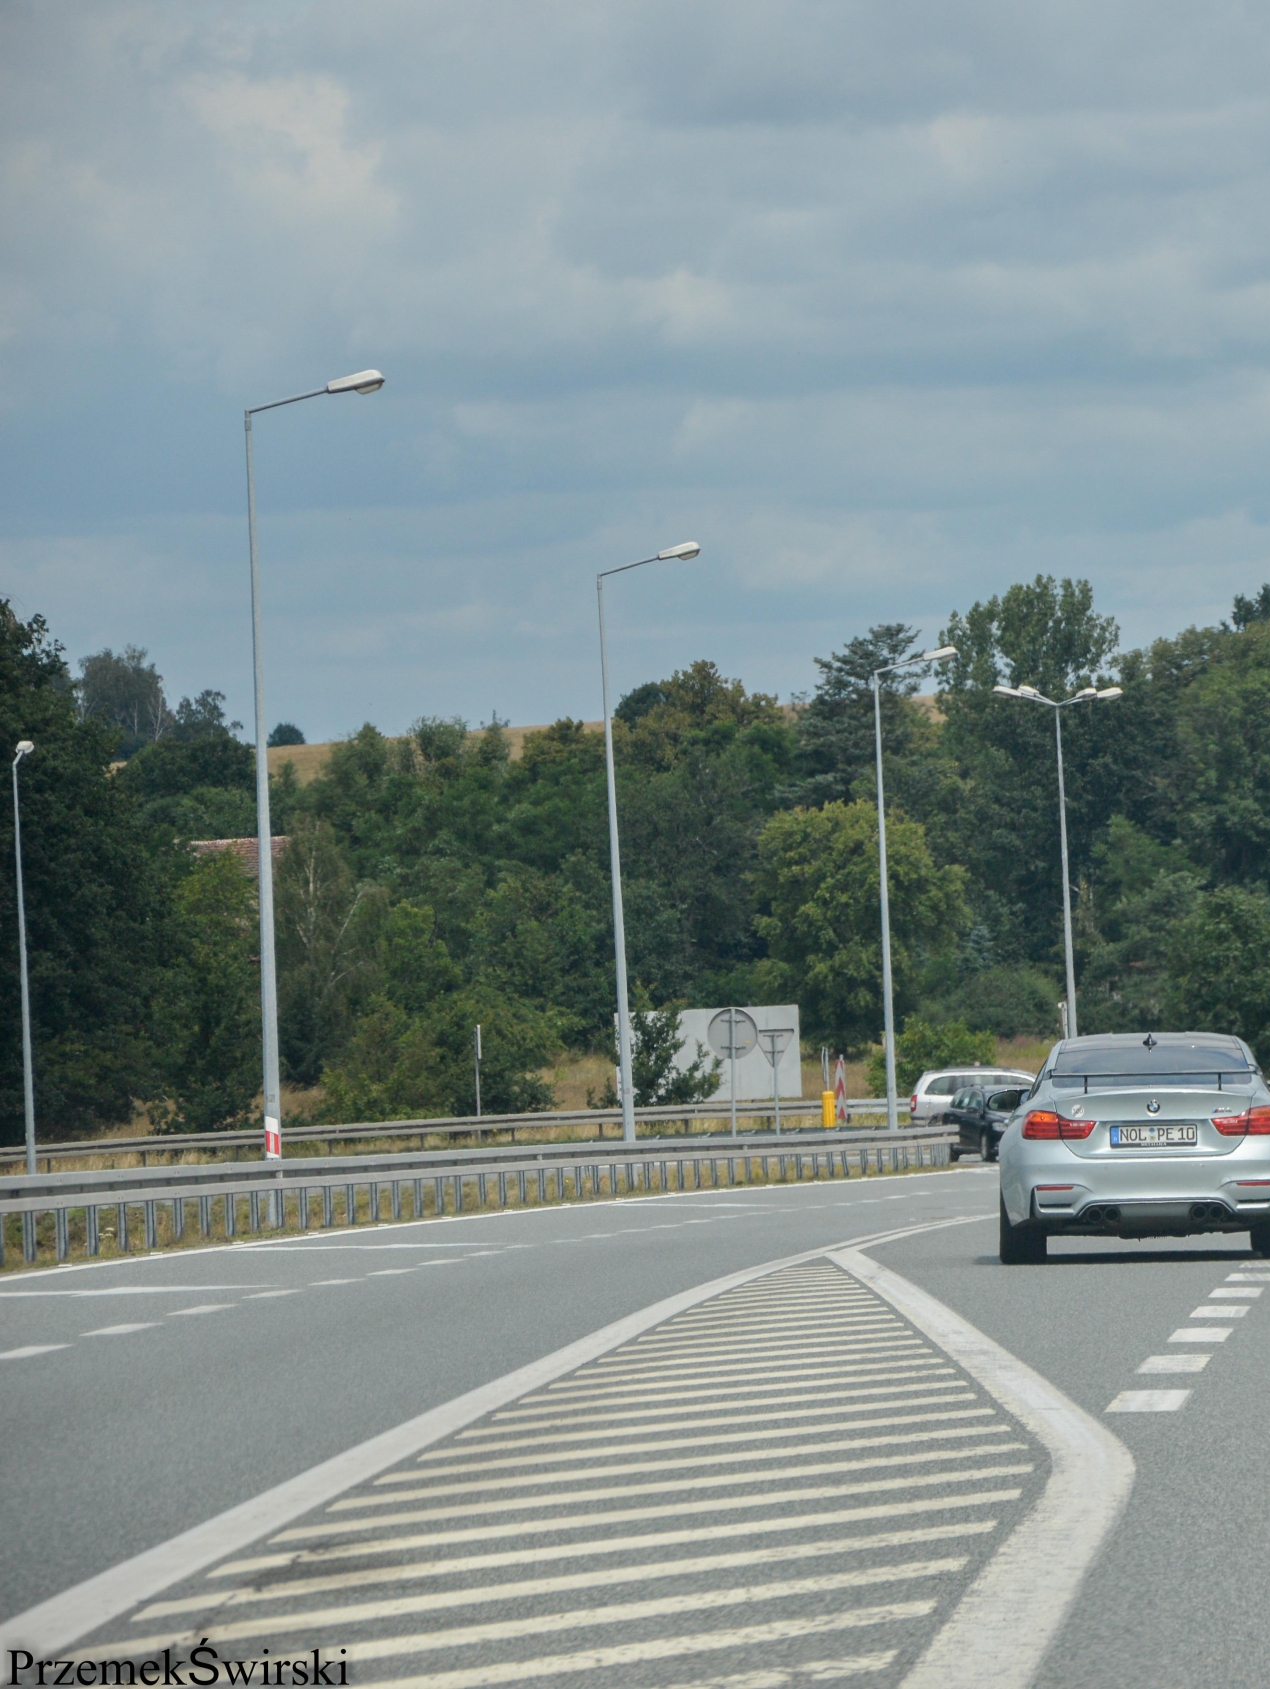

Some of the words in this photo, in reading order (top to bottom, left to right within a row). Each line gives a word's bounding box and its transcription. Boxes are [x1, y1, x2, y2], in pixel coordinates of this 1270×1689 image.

[1119, 1128, 1147, 1143] NOL
[1156, 1127, 1175, 1141] PE
[1178, 1127, 1195, 1141] 10
